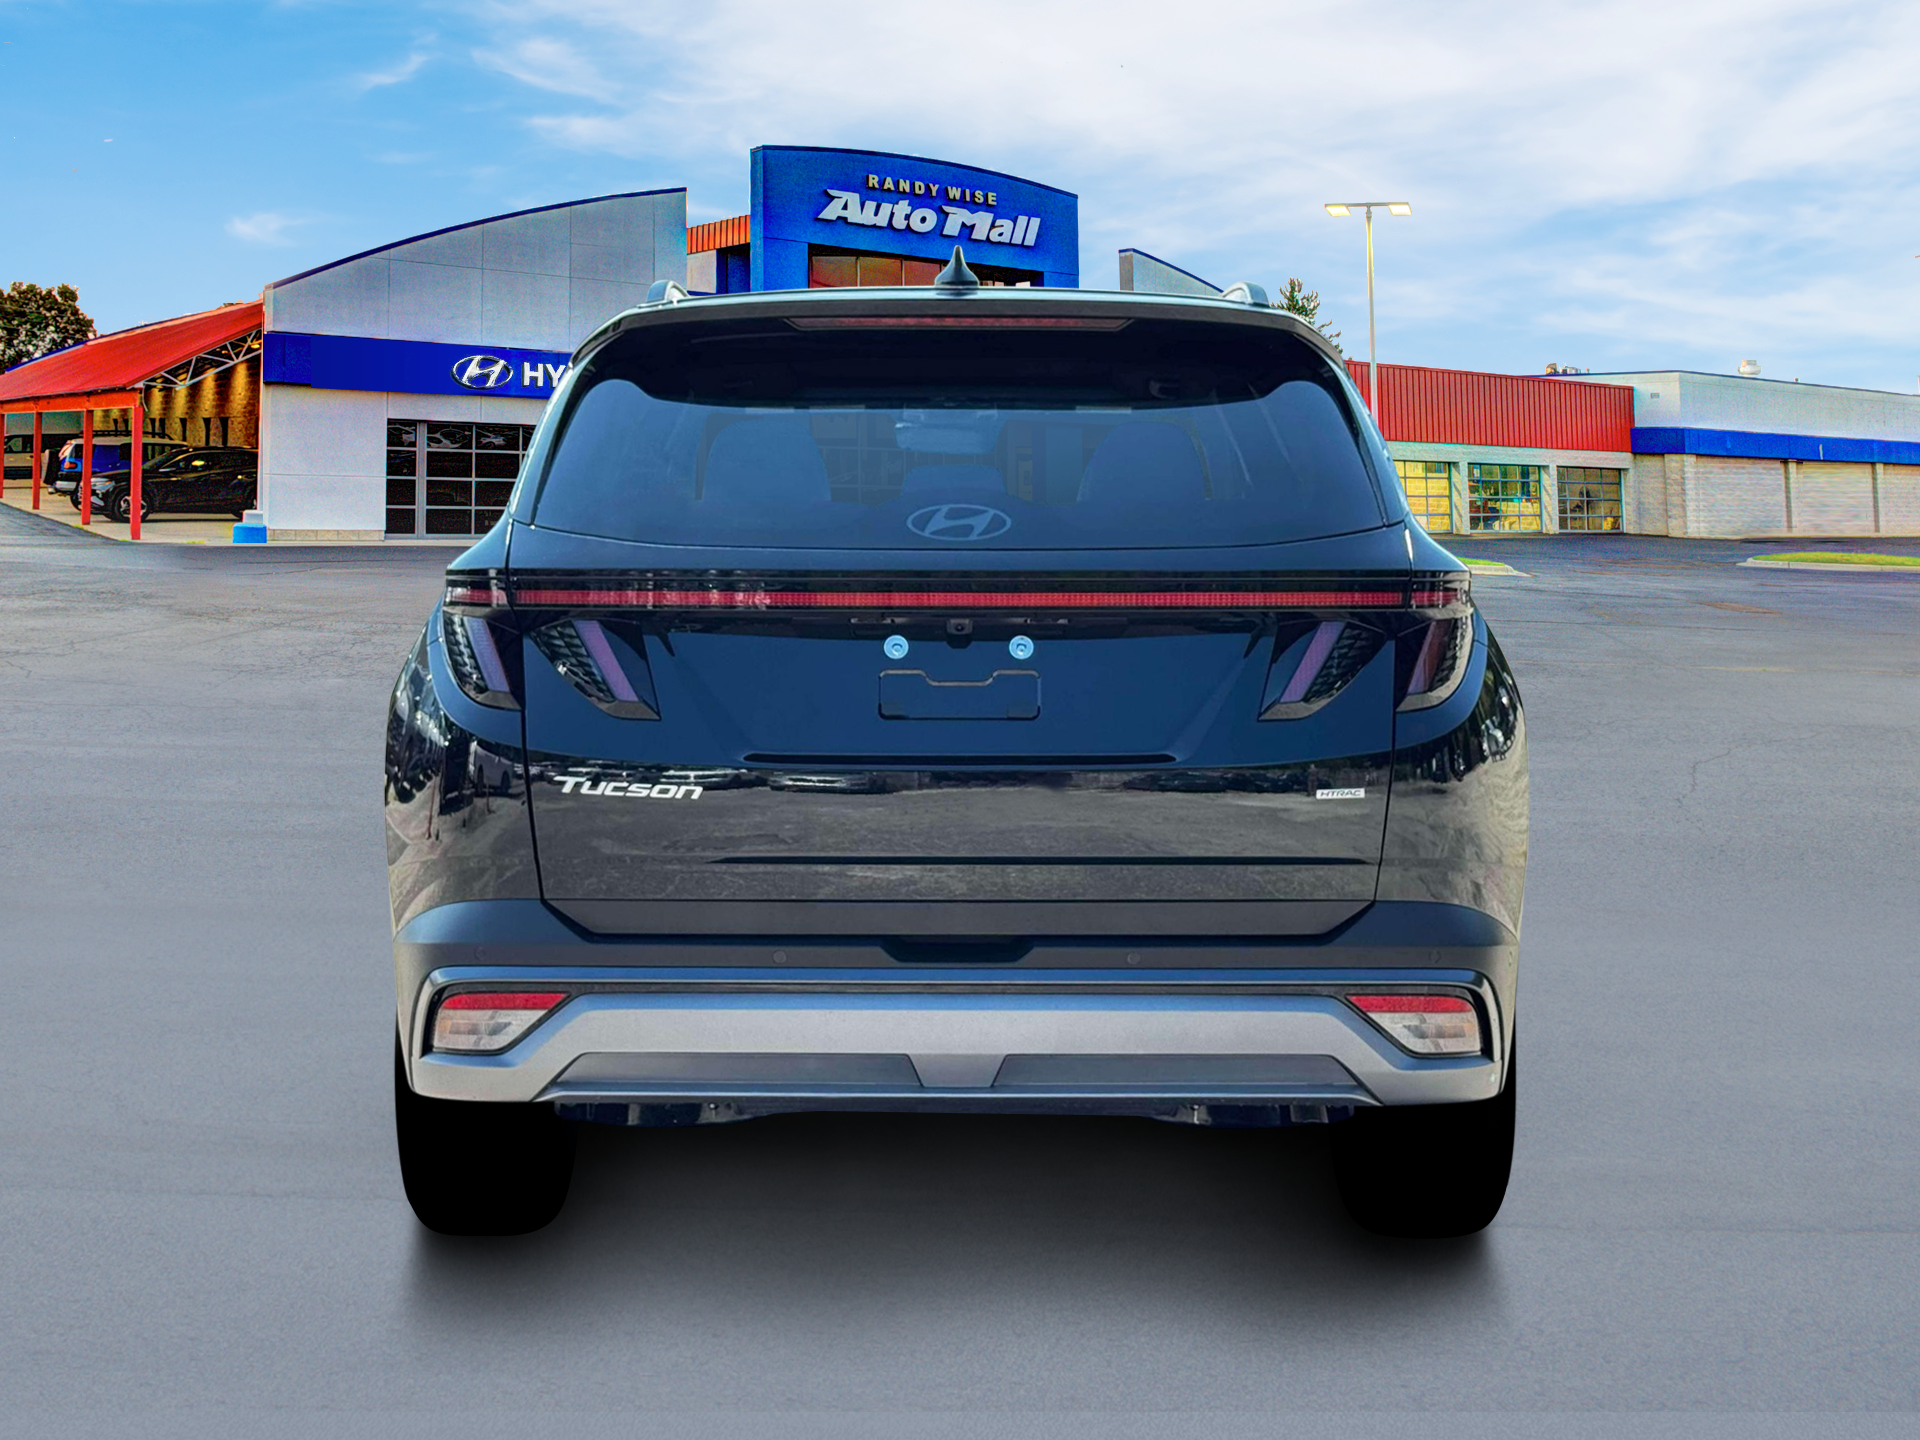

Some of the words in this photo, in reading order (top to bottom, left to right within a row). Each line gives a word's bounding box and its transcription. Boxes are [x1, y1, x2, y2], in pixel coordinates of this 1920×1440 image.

[867, 174, 939, 196] RANDY
[946, 187, 997, 205] WISE
[817, 189, 937, 232] Auto
[941, 205, 1041, 246] Mall
[553, 776, 703, 800] Tucson
[1319, 789, 1363, 798] HTRAC
